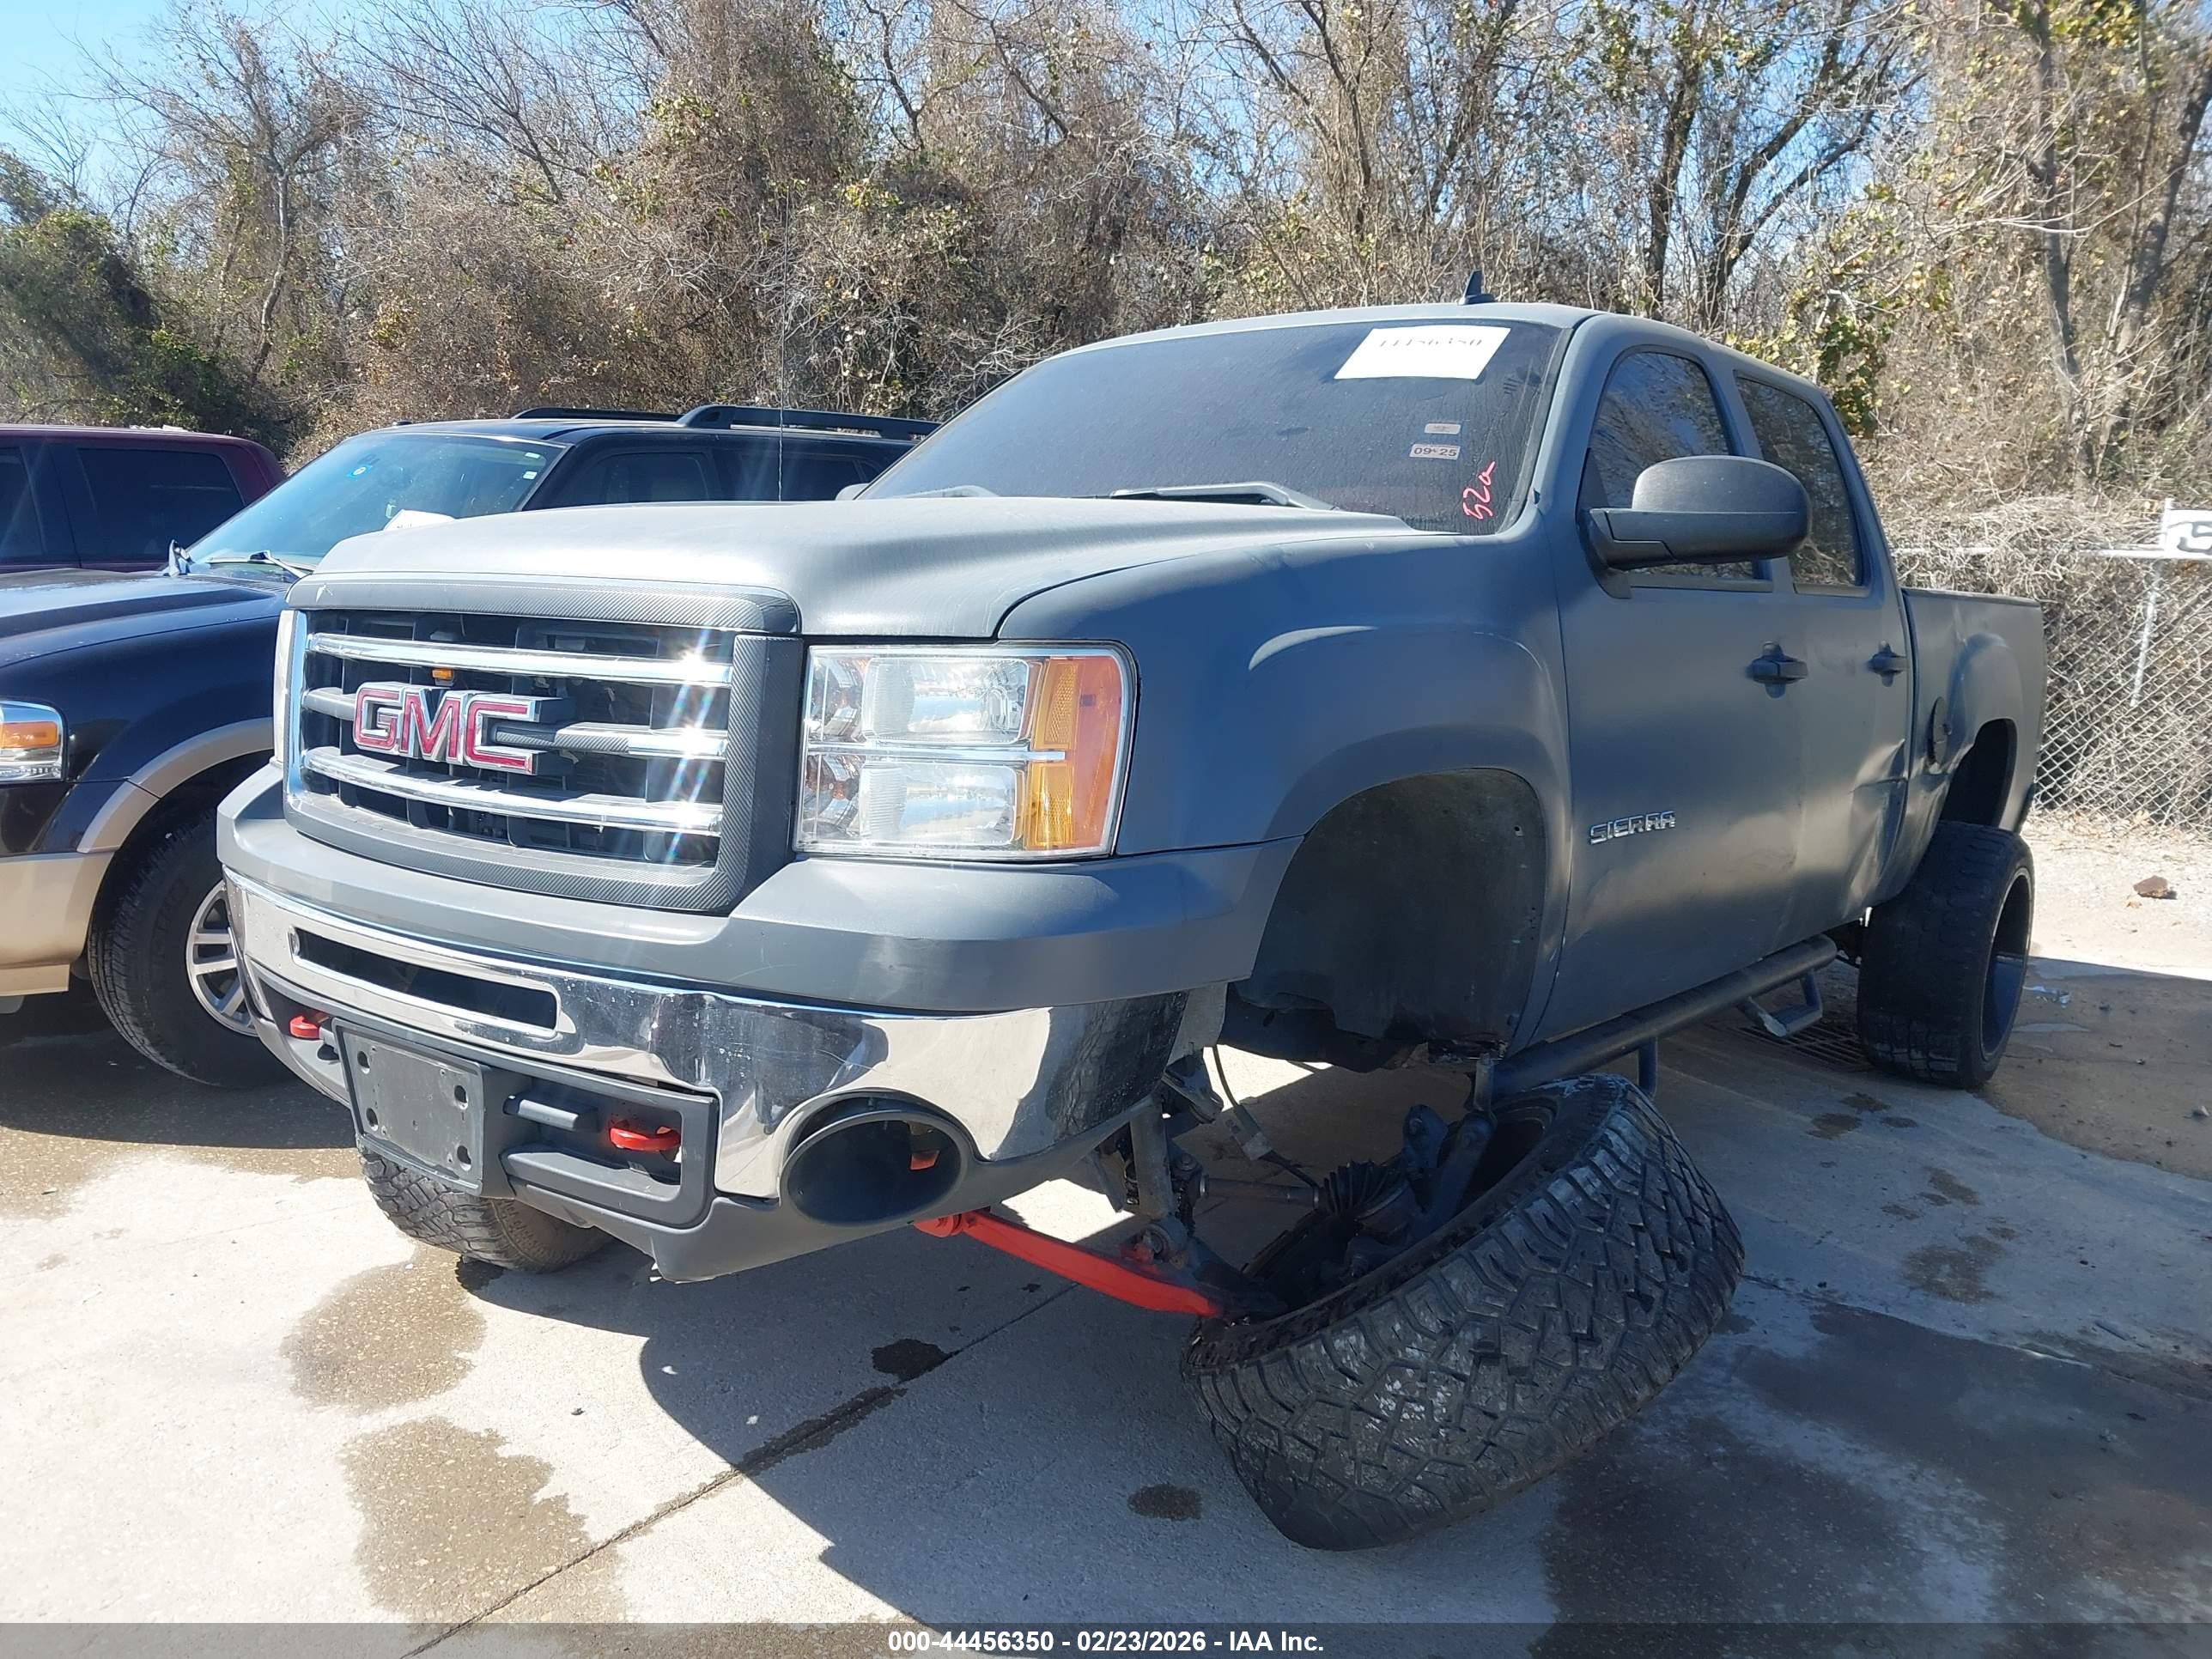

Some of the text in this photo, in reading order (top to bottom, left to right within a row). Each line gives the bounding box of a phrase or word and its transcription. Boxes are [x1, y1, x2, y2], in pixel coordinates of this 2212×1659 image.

[1439, 447, 1457, 457] 25
[352, 681, 541, 776] GMC
[1589, 810, 1676, 845] SIERRA
